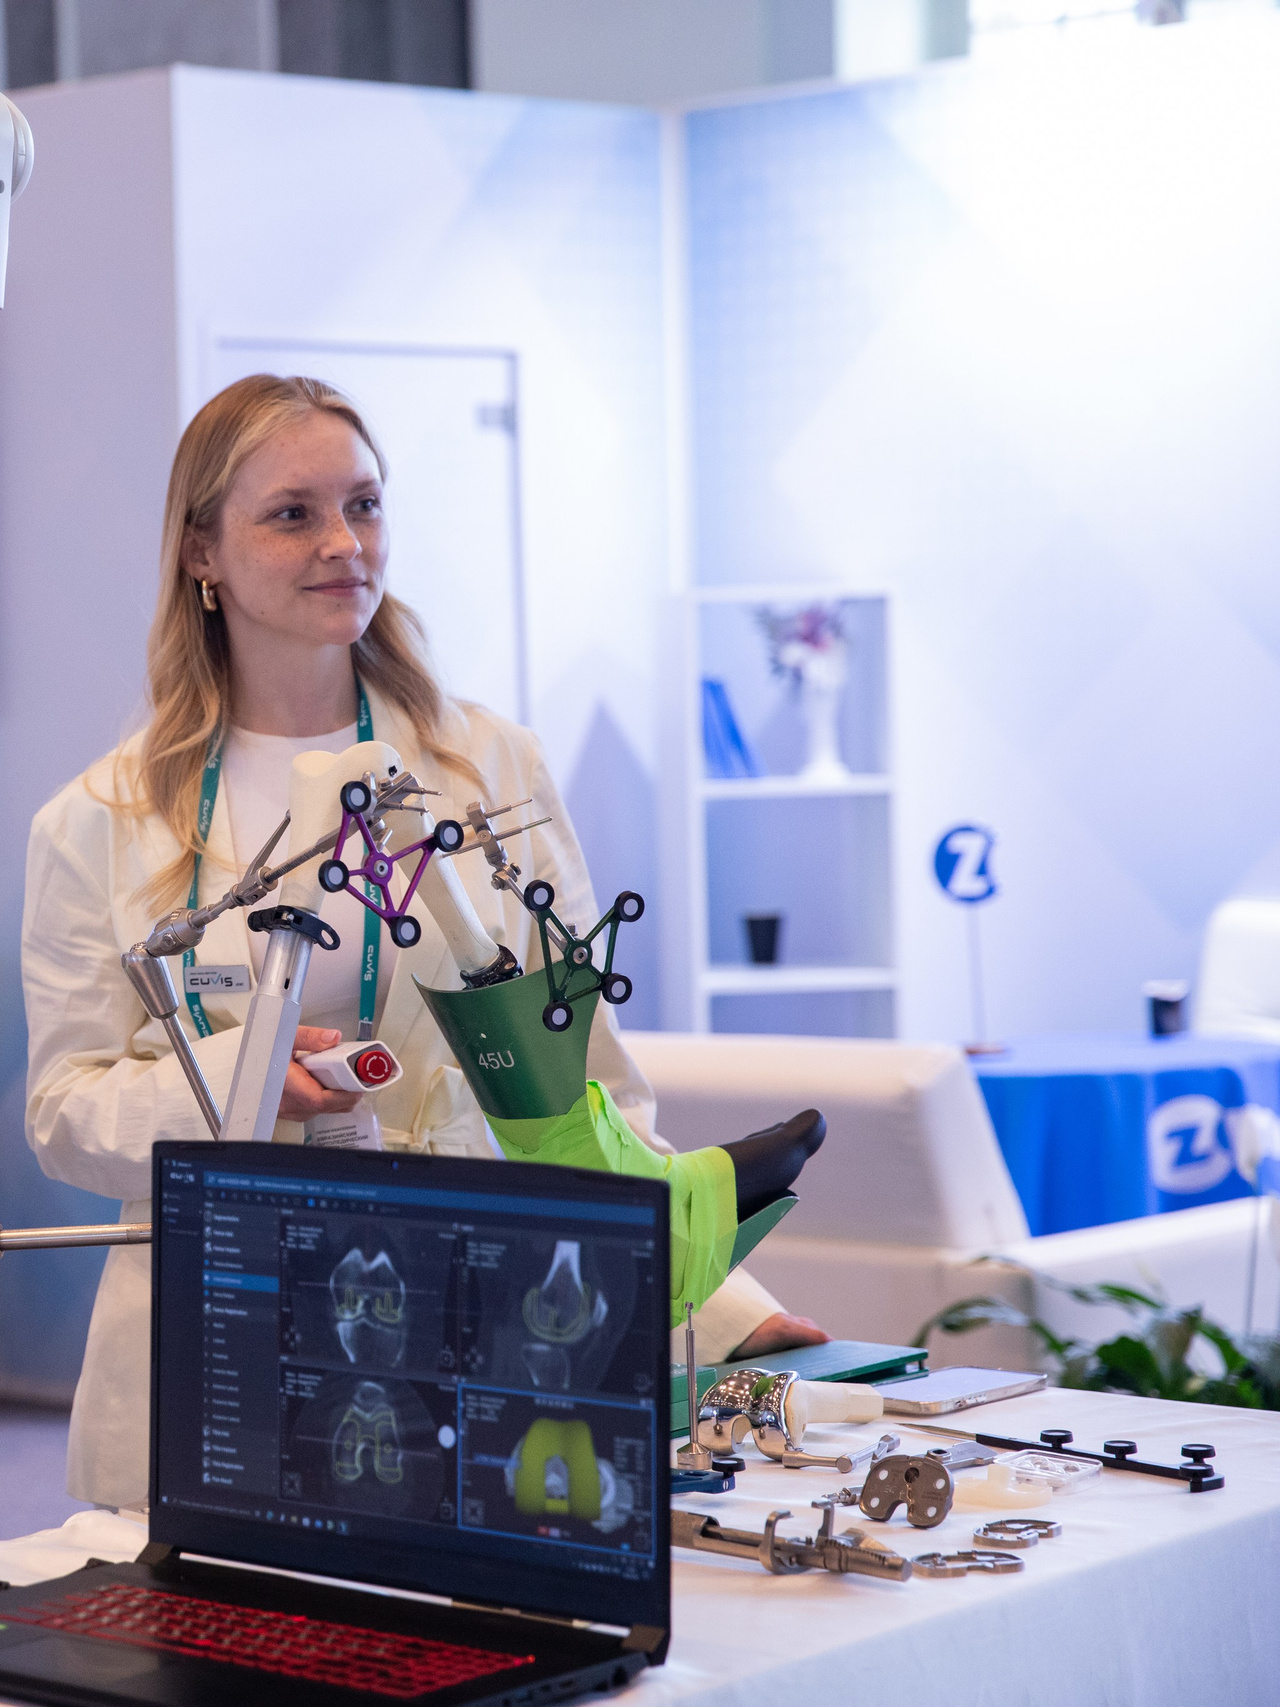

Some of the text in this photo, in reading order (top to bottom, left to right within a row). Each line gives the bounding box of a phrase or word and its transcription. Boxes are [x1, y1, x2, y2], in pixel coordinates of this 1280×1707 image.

[364, 944, 375, 982] CUVIS
[190, 973, 233, 987] CUVIS
[478, 1050, 515, 1069] 45U
